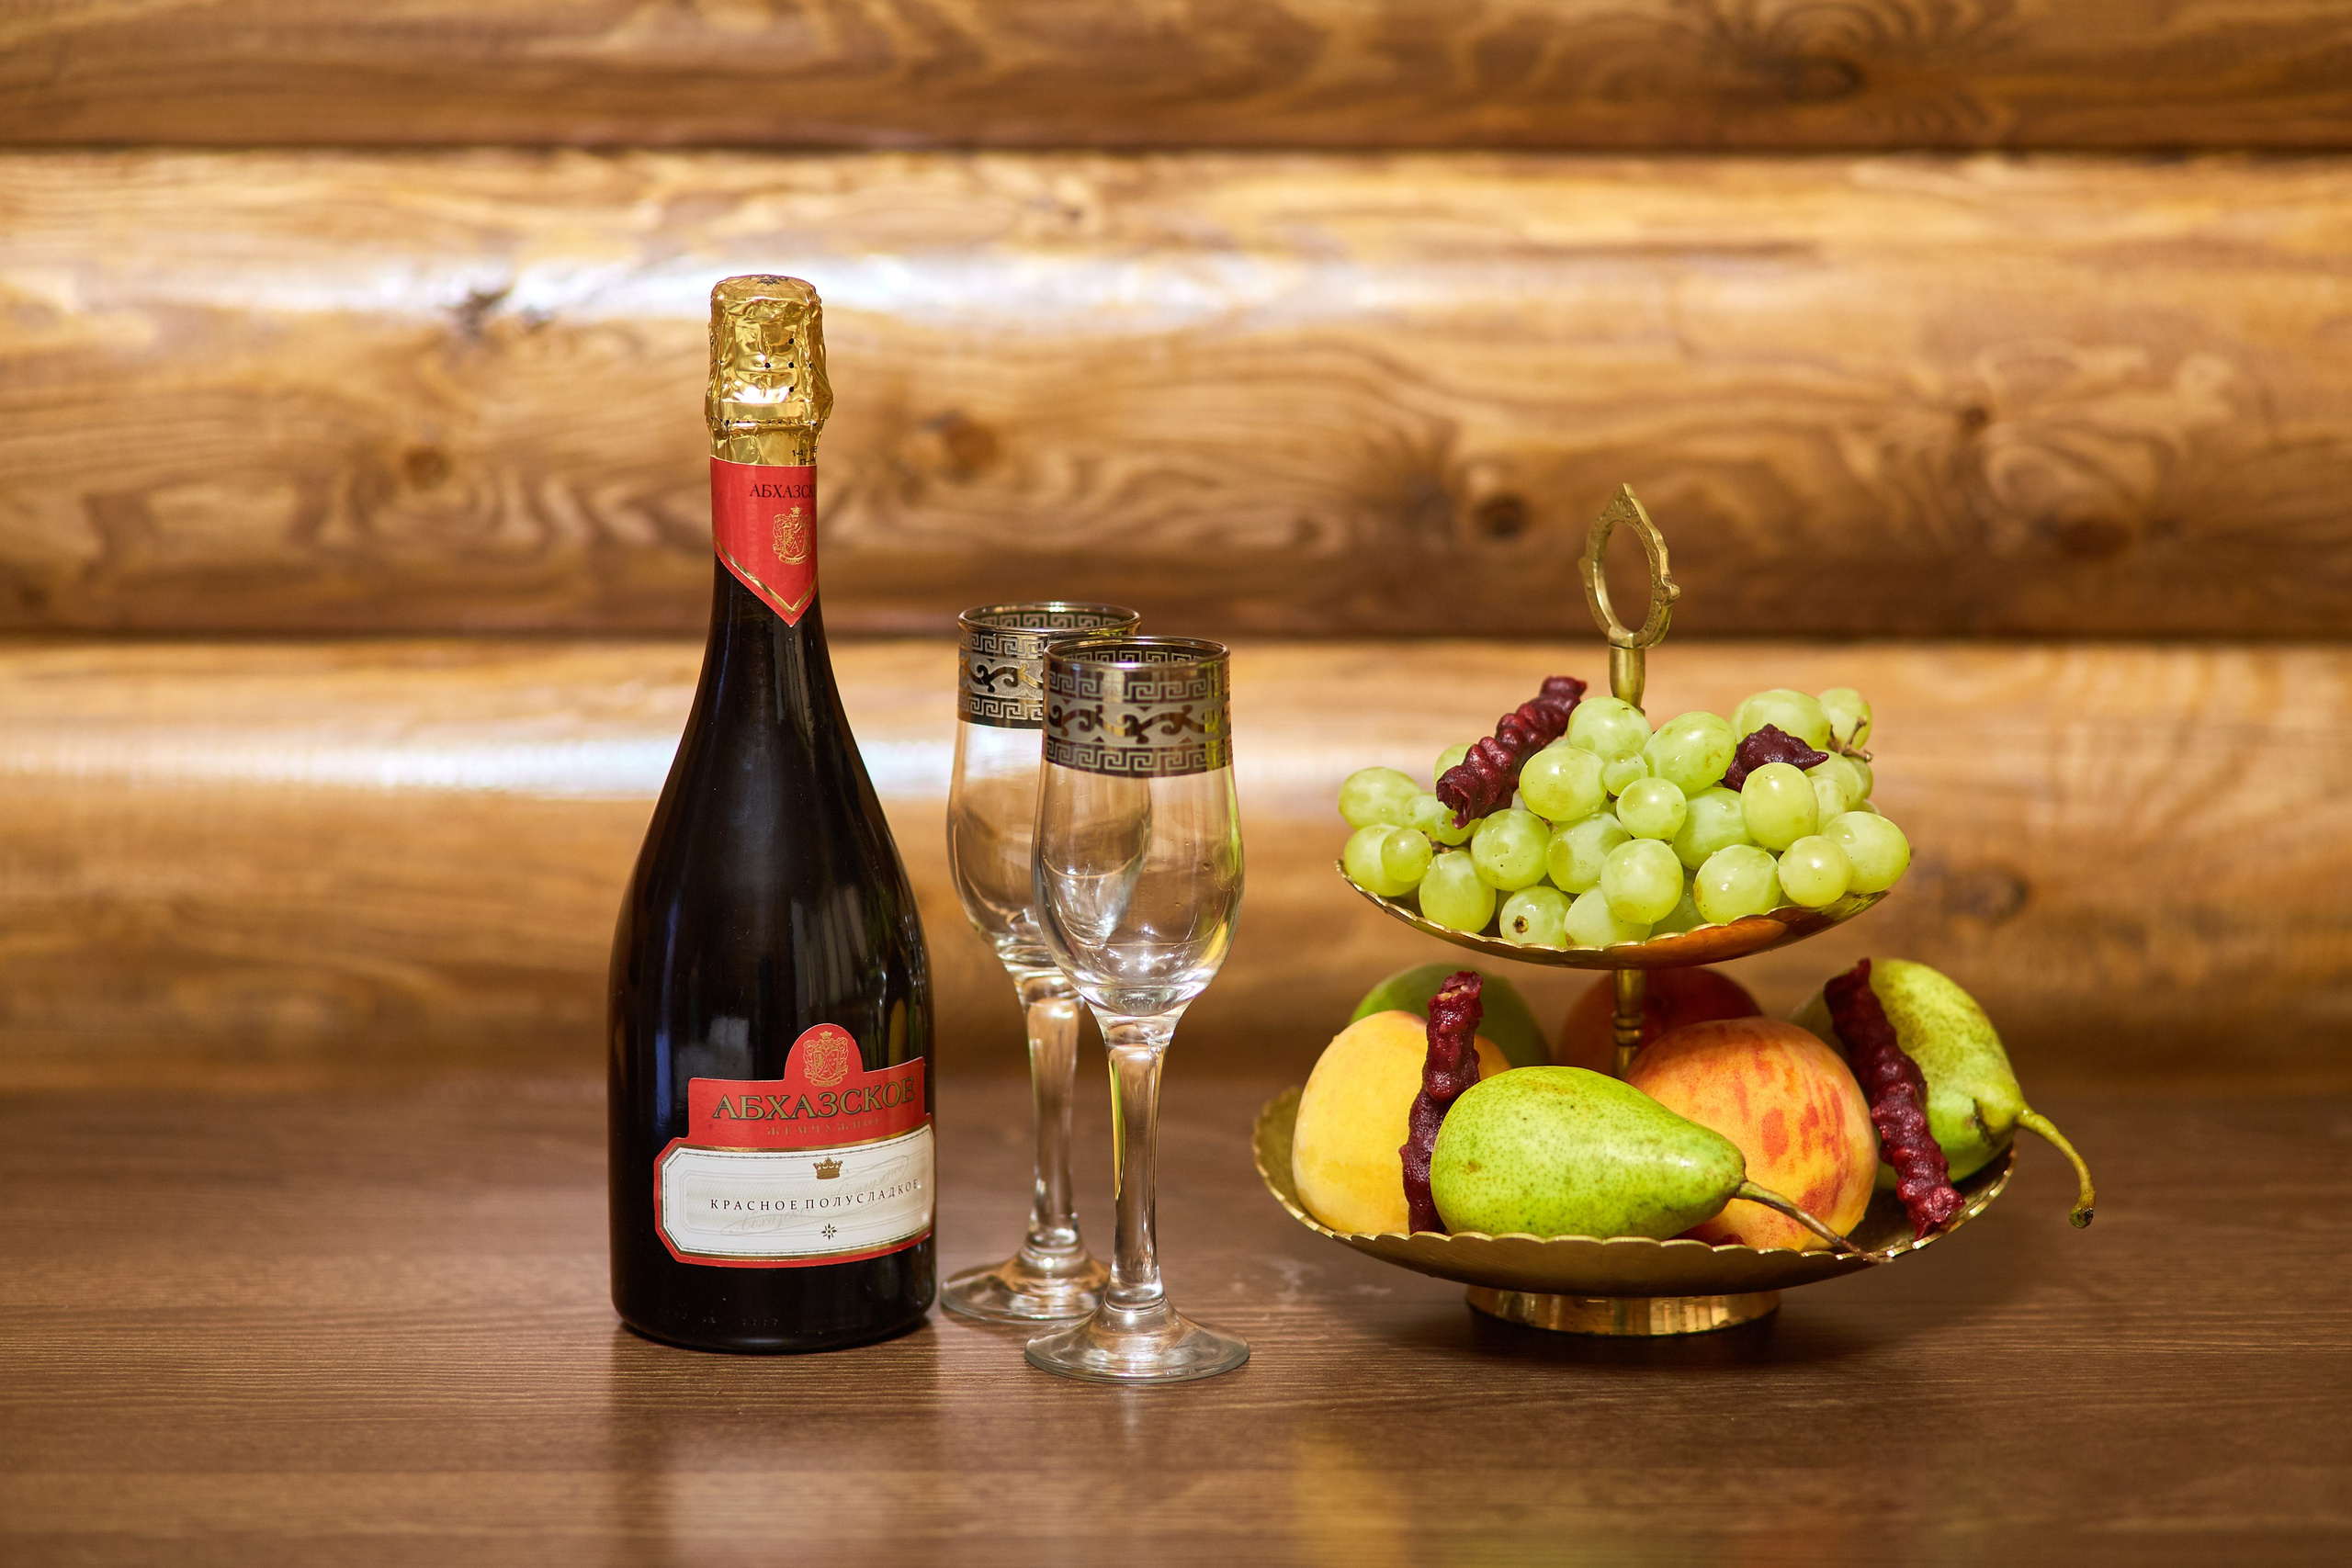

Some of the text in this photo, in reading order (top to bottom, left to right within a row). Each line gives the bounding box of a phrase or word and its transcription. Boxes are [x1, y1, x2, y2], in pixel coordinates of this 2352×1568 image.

[712, 1077, 915, 1121] АБХАЗСКОЕ
[710, 1199, 797, 1211] КРАСНОЕ
[806, 1179, 918, 1209] ПОЛУСЛАДКОЕ
